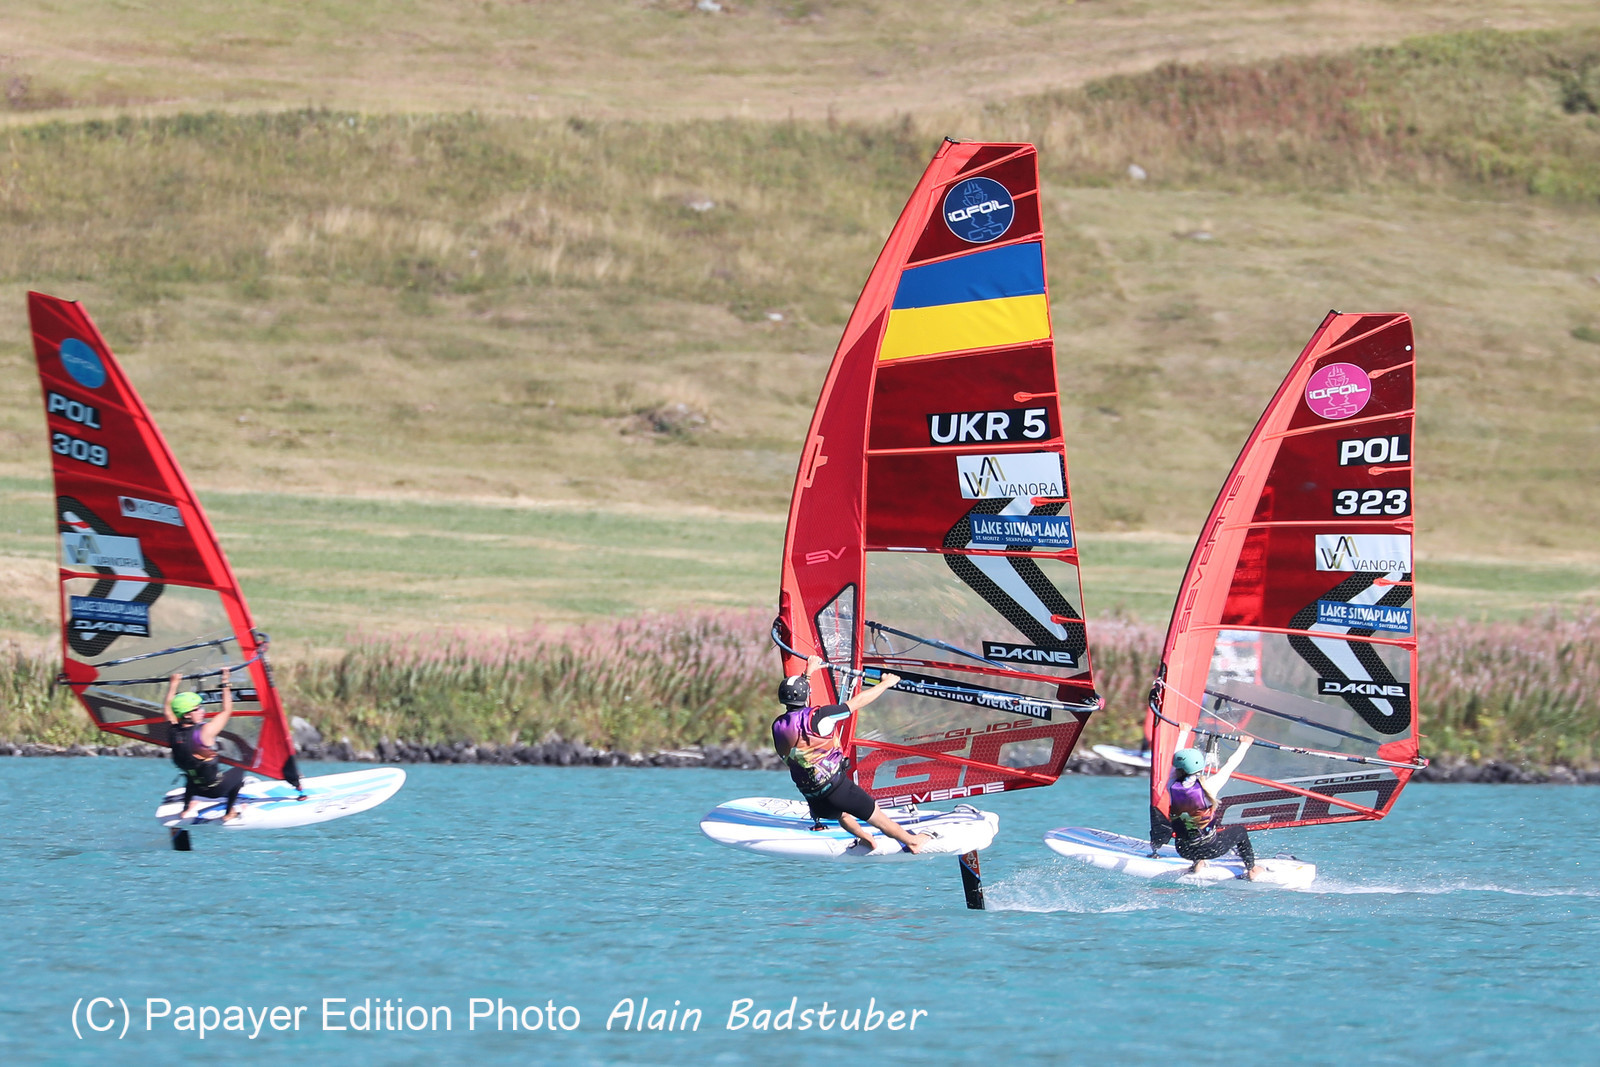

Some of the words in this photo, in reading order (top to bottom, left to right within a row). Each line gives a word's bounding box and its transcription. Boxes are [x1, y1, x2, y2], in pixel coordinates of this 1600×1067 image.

[49, 392, 101, 430] POL
[930, 411, 1010, 444] UKR
[1022, 408, 1046, 439] 5
[53, 433, 108, 467] 309
[1340, 436, 1409, 466] POL
[998, 482, 1059, 497] VANORA
[1335, 489, 1408, 515] 323
[973, 519, 1002, 535] LAKE
[1352, 559, 1407, 572] VANORA
[1320, 603, 1347, 618] LAKE
[988, 645, 1074, 665] DAKINE
[1322, 681, 1407, 697] DAKINE
[945, 718, 1033, 739] GLIDE
[1314, 773, 1381, 785] GLIDE
[875, 781, 1005, 809] SEVERNE
